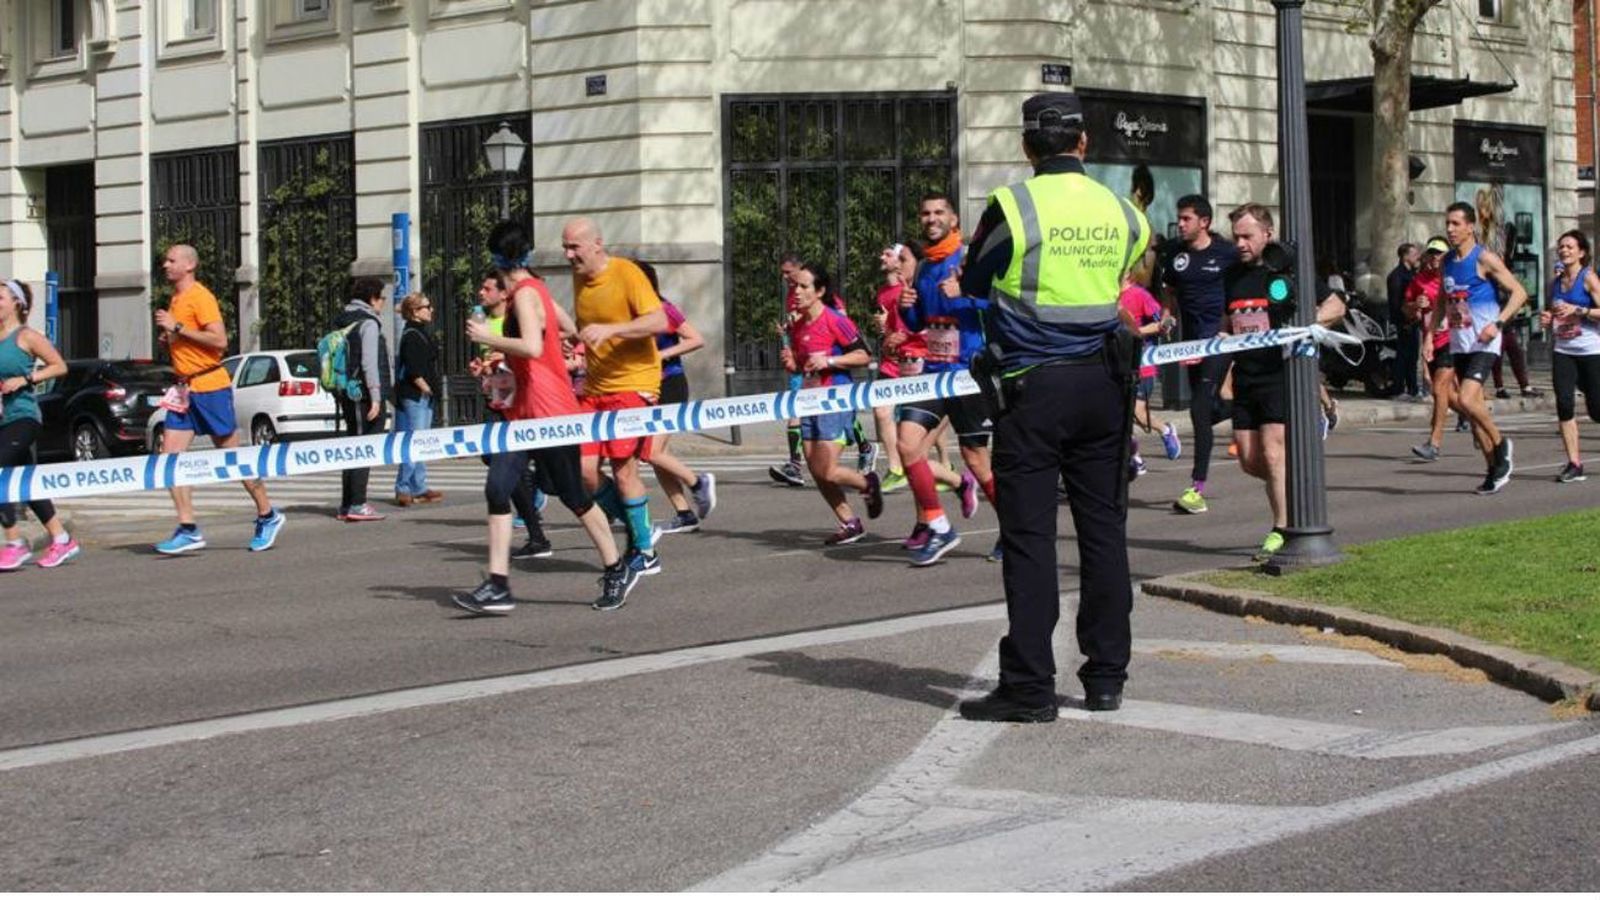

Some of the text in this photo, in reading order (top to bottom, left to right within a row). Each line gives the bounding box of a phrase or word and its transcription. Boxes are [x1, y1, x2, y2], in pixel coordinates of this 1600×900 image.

[1049, 244, 1119, 256] MUNICIPAL
[1078, 257, 1120, 269] Madrid
[1157, 344, 1201, 359] NO PASAR
[874, 381, 930, 399] NO PASAR
[705, 401, 768, 421] NO PASAR
[513, 422, 586, 444] NO PASAR
[295, 444, 376, 466] NO PASAR
[41, 467, 136, 490] NO PASAR
